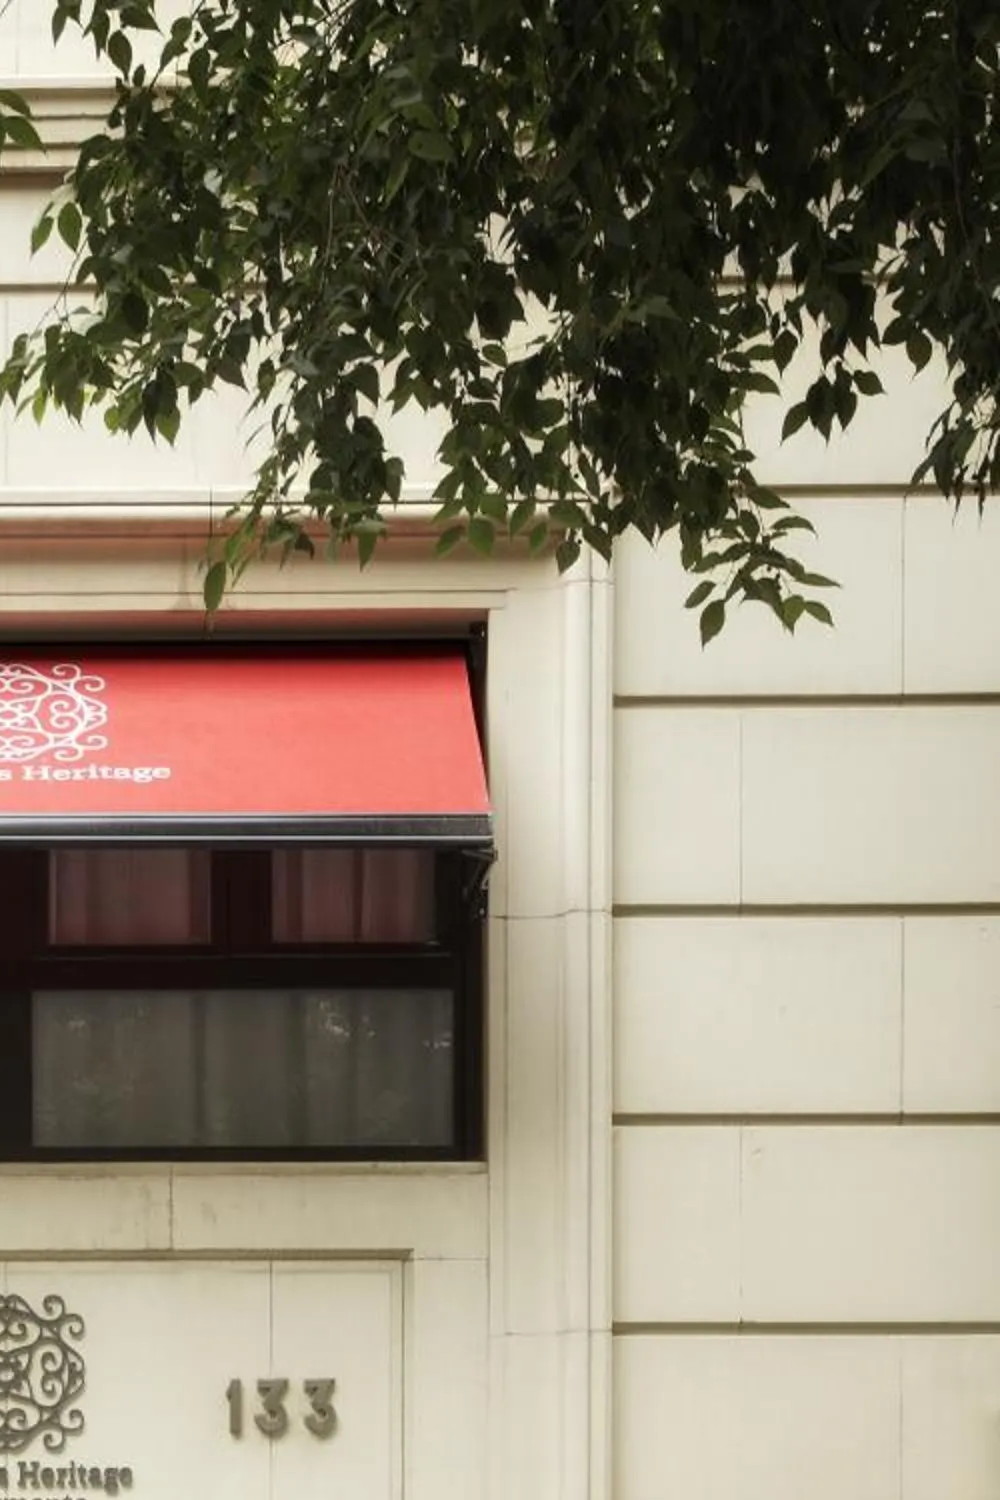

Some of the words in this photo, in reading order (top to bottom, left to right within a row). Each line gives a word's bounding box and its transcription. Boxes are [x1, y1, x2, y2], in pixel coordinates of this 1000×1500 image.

[22, 763, 172, 783] Heritage
[225, 1378, 338, 1440] 133
[17, 1459, 134, 1496] Heritage
